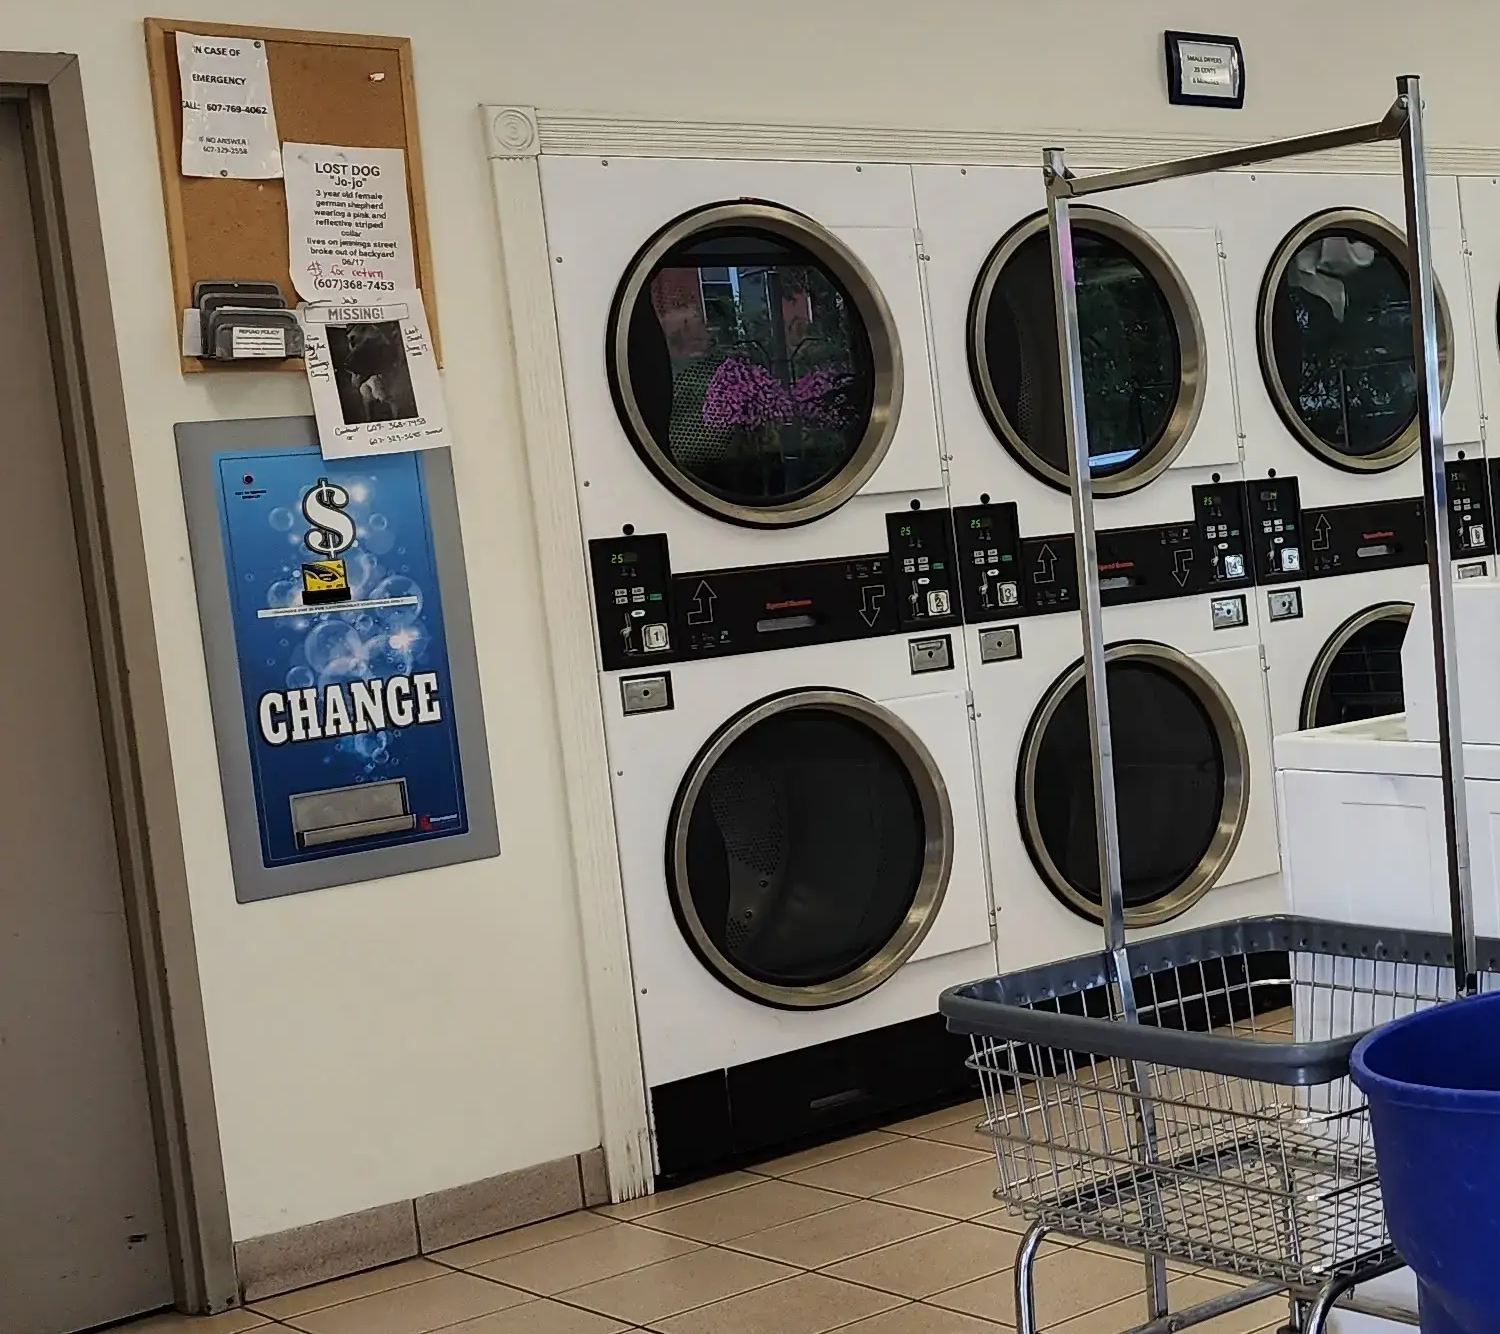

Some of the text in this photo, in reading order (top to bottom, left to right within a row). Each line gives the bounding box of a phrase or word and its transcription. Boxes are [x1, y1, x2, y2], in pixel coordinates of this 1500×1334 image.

[204, 46, 228, 56] CASE
[229, 48, 241, 57] OF
[192, 73, 246, 85] EMERGENCY
[206, 103, 268, 115] 607-769-4062
[315, 162, 380, 177] LOST DOG
[315, 189, 383, 200] 3 year old female
[315, 200, 384, 210] german shepherd
[314, 210, 345, 218] wearing
[353, 212, 370, 220] pink
[371, 212, 387, 220] and
[315, 219, 384, 230] reflective striped
[307, 237, 326, 245] lives
[310, 247, 333, 255] broke
[359, 250, 394, 259] backyard
[352, 268, 384, 279] return
[314, 278, 395, 291] (607)368-7453
[328, 307, 384, 320] MISSING!
[970, 519, 981, 528] 25
[901, 526, 911, 536] 25
[611, 553, 624, 563] 25
[934, 595, 944, 607] 2
[653, 631, 660, 642] 1
[259, 672, 441, 744] CHANGE
